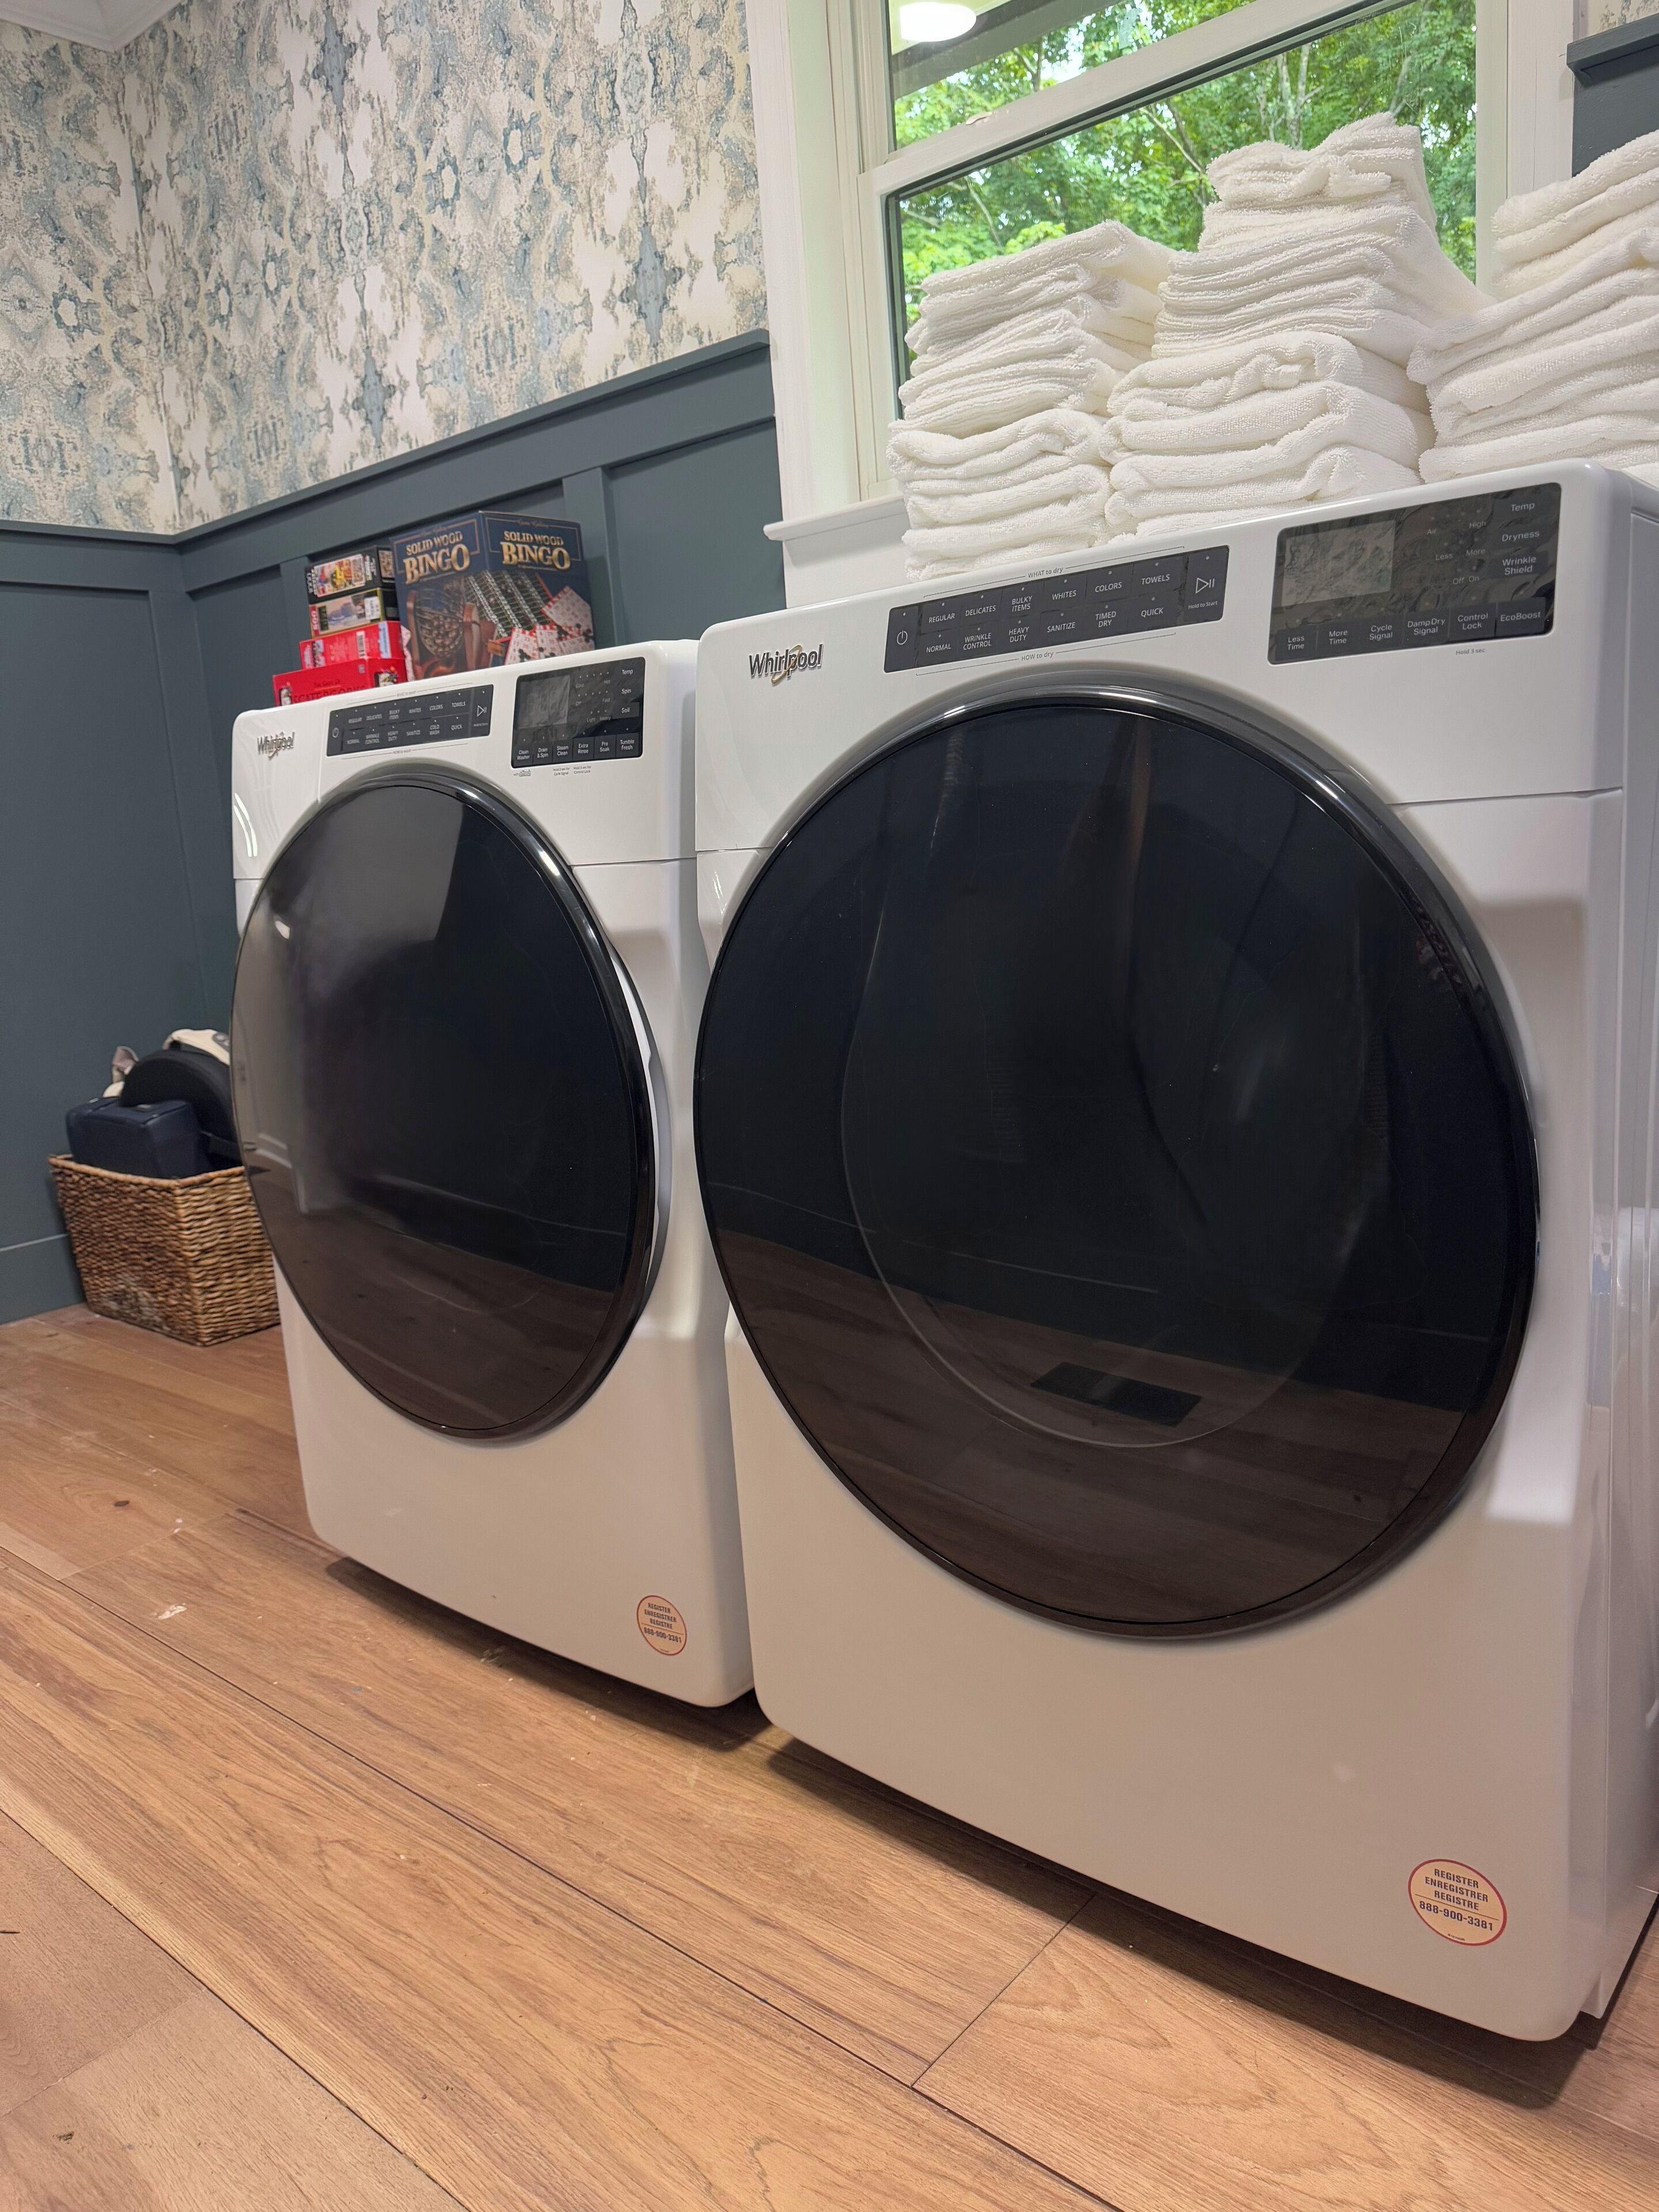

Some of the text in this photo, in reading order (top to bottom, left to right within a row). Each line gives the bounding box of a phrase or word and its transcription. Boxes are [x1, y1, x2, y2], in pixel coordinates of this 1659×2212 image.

[1512, 502, 1535, 512] Temp
[1469, 521, 1486, 530] High
[503, 531, 564, 546] SOLID WOOD
[1502, 530, 1540, 542] Dryness
[406, 531, 463, 555] SOLID WOOD
[500, 542, 571, 570] BINGO
[1466, 548, 1485, 556] More
[403, 544, 470, 585] BINGO
[1502, 556, 1536, 566] Wrinkle
[1028, 570, 1044, 578] WHAT
[1054, 567, 1063, 575] dry
[1504, 566, 1533, 575] Shield
[1141, 574, 1170, 585] TOWELS
[1453, 577, 1465, 585] Off
[1095, 582, 1122, 592] COLORS
[1012, 595, 1032, 605] BULKY
[1052, 590, 1077, 600] WHITES
[965, 605, 996, 616] DELICATES
[1012, 603, 1030, 612] ITEMS
[1141, 607, 1163, 618] QUICK
[929, 613, 955, 623] REGULAR
[1096, 611, 1116, 620] TIMED
[1458, 613, 1488, 622] Control
[1501, 612, 1541, 622] EcoBoost
[1047, 622, 1075, 632] SANITIZE
[1098, 619, 1112, 628] DRY
[1371, 624, 1392, 633] Cycle
[1463, 621, 1482, 630] Lock
[1009, 627, 1029, 635] HEAVY
[1414, 626, 1438, 635] Signal
[964, 633, 991, 643] WRINKLE
[1009, 634, 1027, 643] DUTY
[1369, 632, 1392, 641] Signal
[926, 643, 951, 653] NORMAL
[963, 640, 991, 650] CONTROL
[749, 644, 823, 677] Whirlpool
[1044, 652, 1054, 660] dry
[648, 1603, 671, 1613] REGISTER
[645, 1609, 677, 1623] ENREGISTRER
[650, 1618, 673, 1629] REGISTRE
[1434, 1868, 1479, 1888] REGISTER
[1425, 1876, 1488, 1902] ENREGISTRER
[1434, 1890, 1479, 1911] REGISTRE
[1419, 1900, 1493, 1931] 888-900-3381
